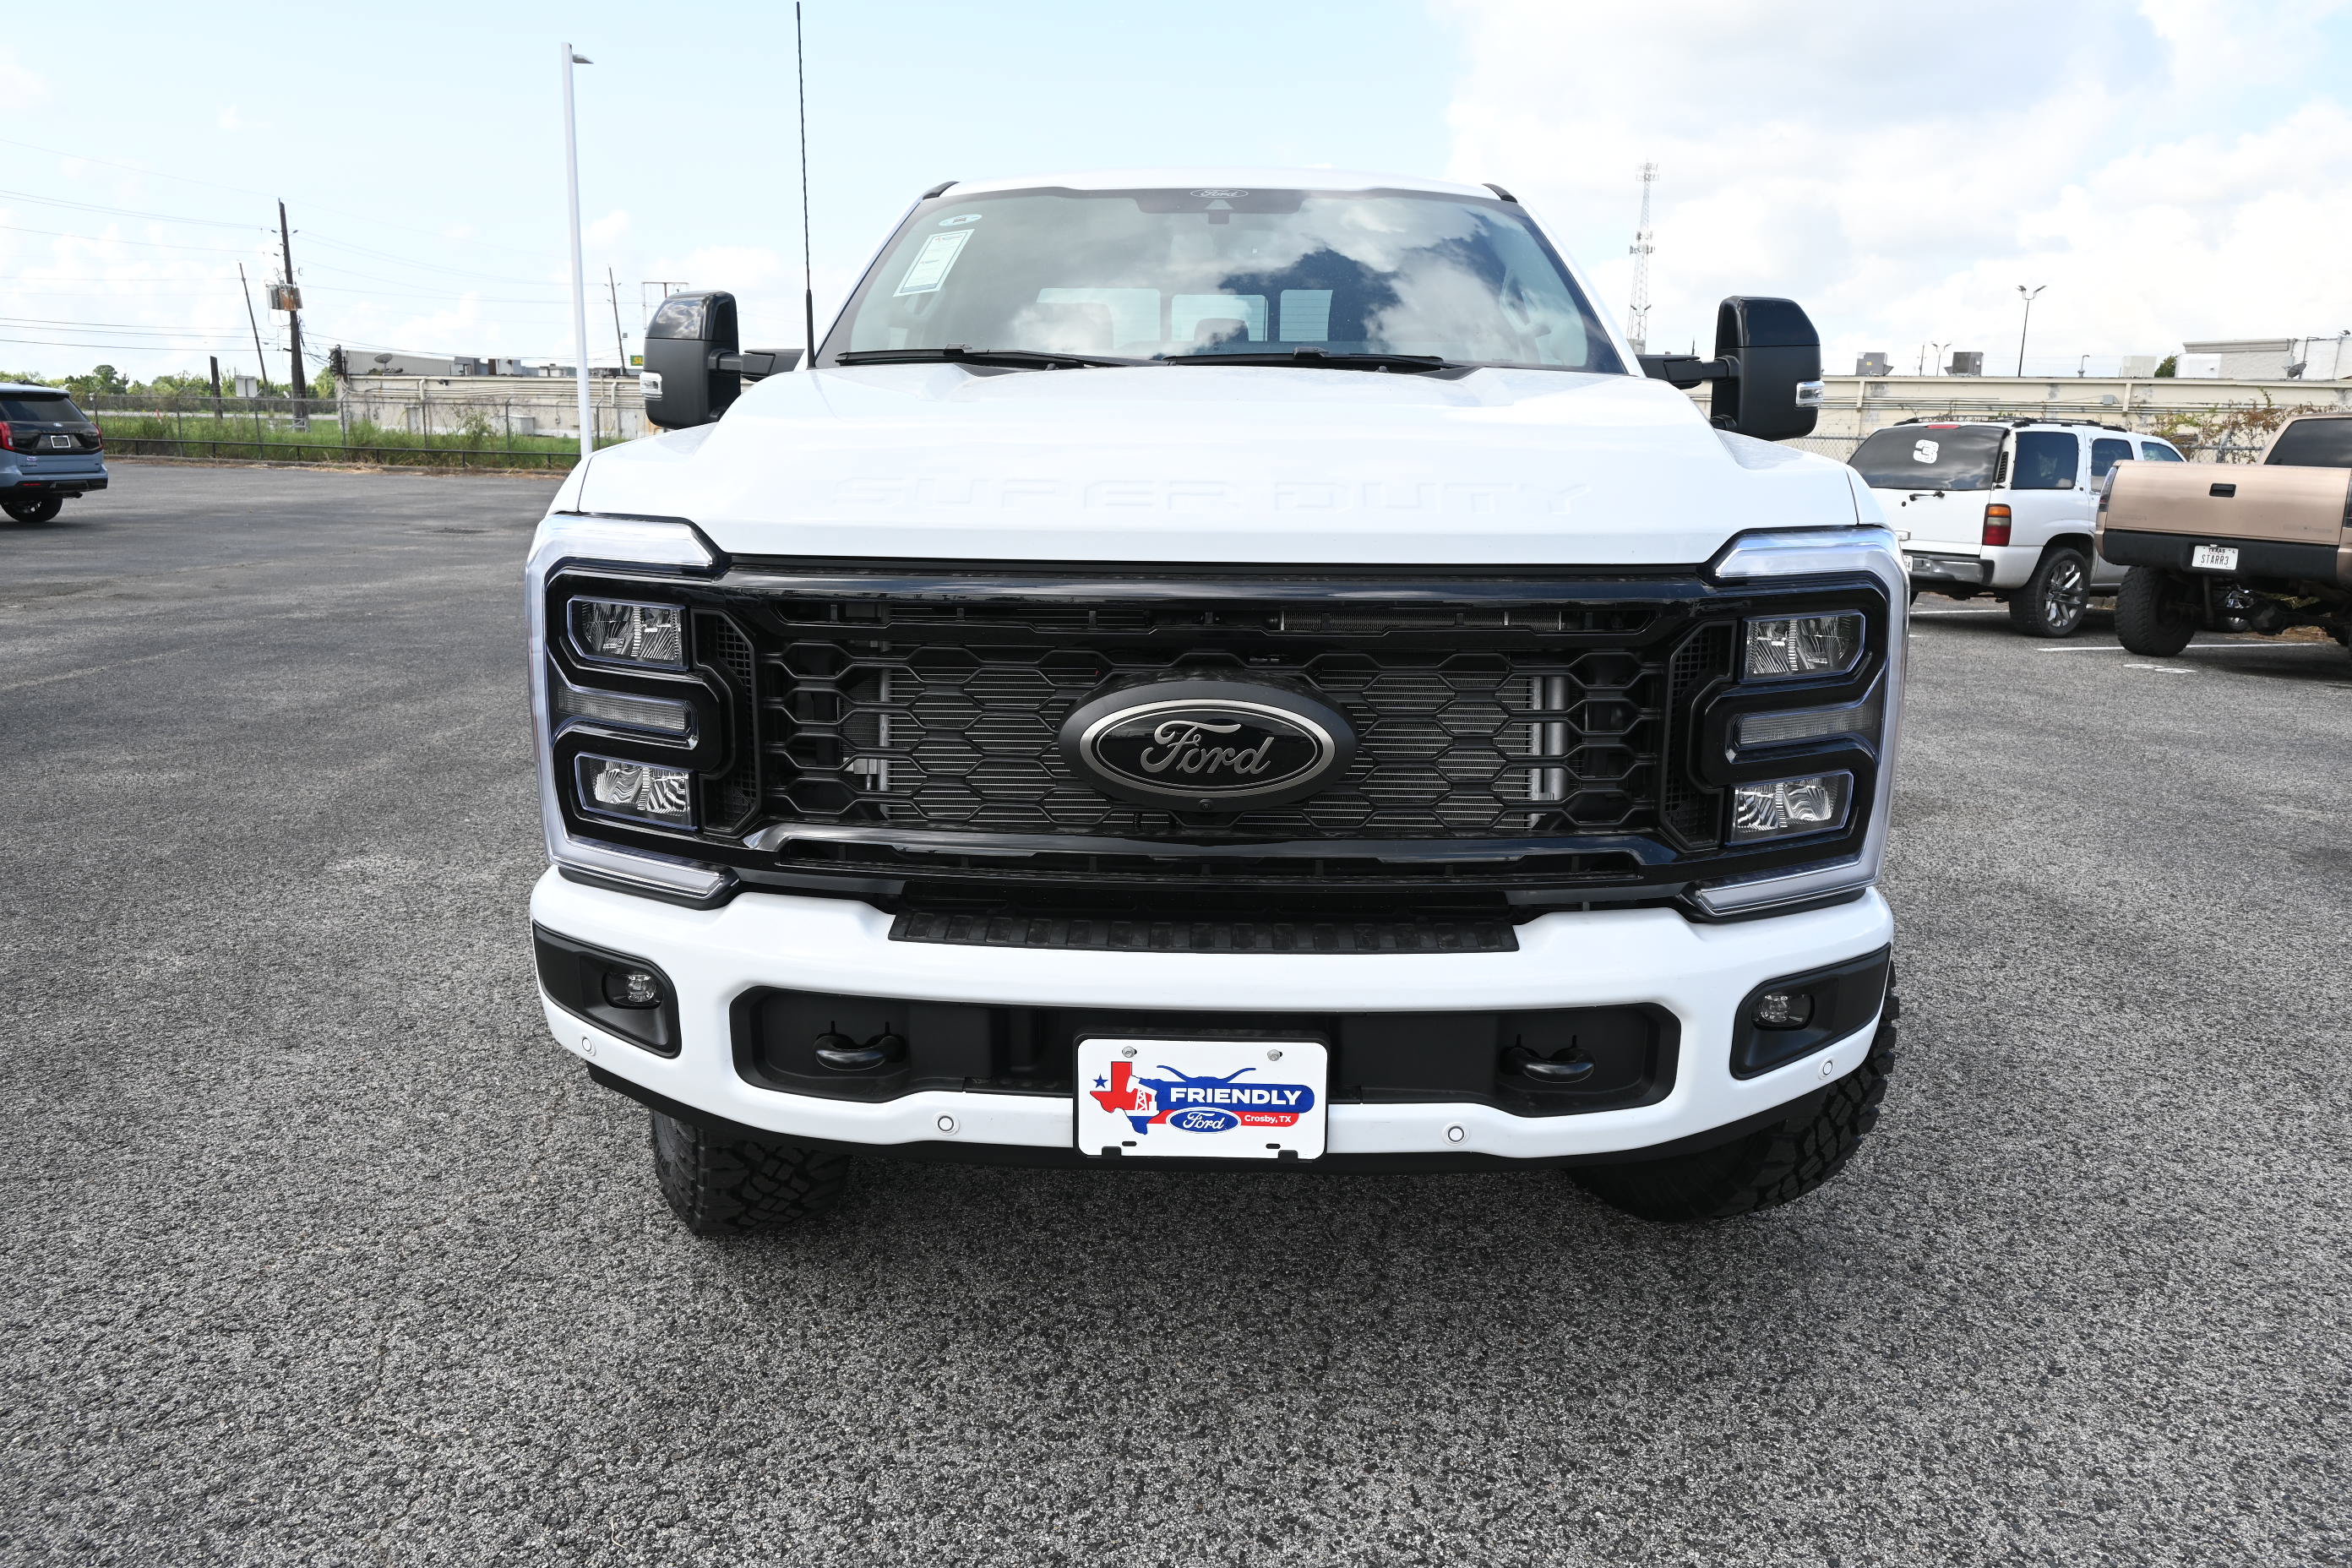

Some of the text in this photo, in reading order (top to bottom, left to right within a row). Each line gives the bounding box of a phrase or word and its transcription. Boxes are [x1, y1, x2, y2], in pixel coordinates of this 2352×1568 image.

[1913, 439, 1939, 464] 3
[831, 476, 1592, 514] SUPER DUTY
[2201, 554, 2230, 565] STARR3
[1141, 720, 1274, 774] Ford
[1170, 1087, 1302, 1105] FRIENDLY
[1183, 1112, 1224, 1130] Ford
[1244, 1114, 1277, 1124] Crosby,
